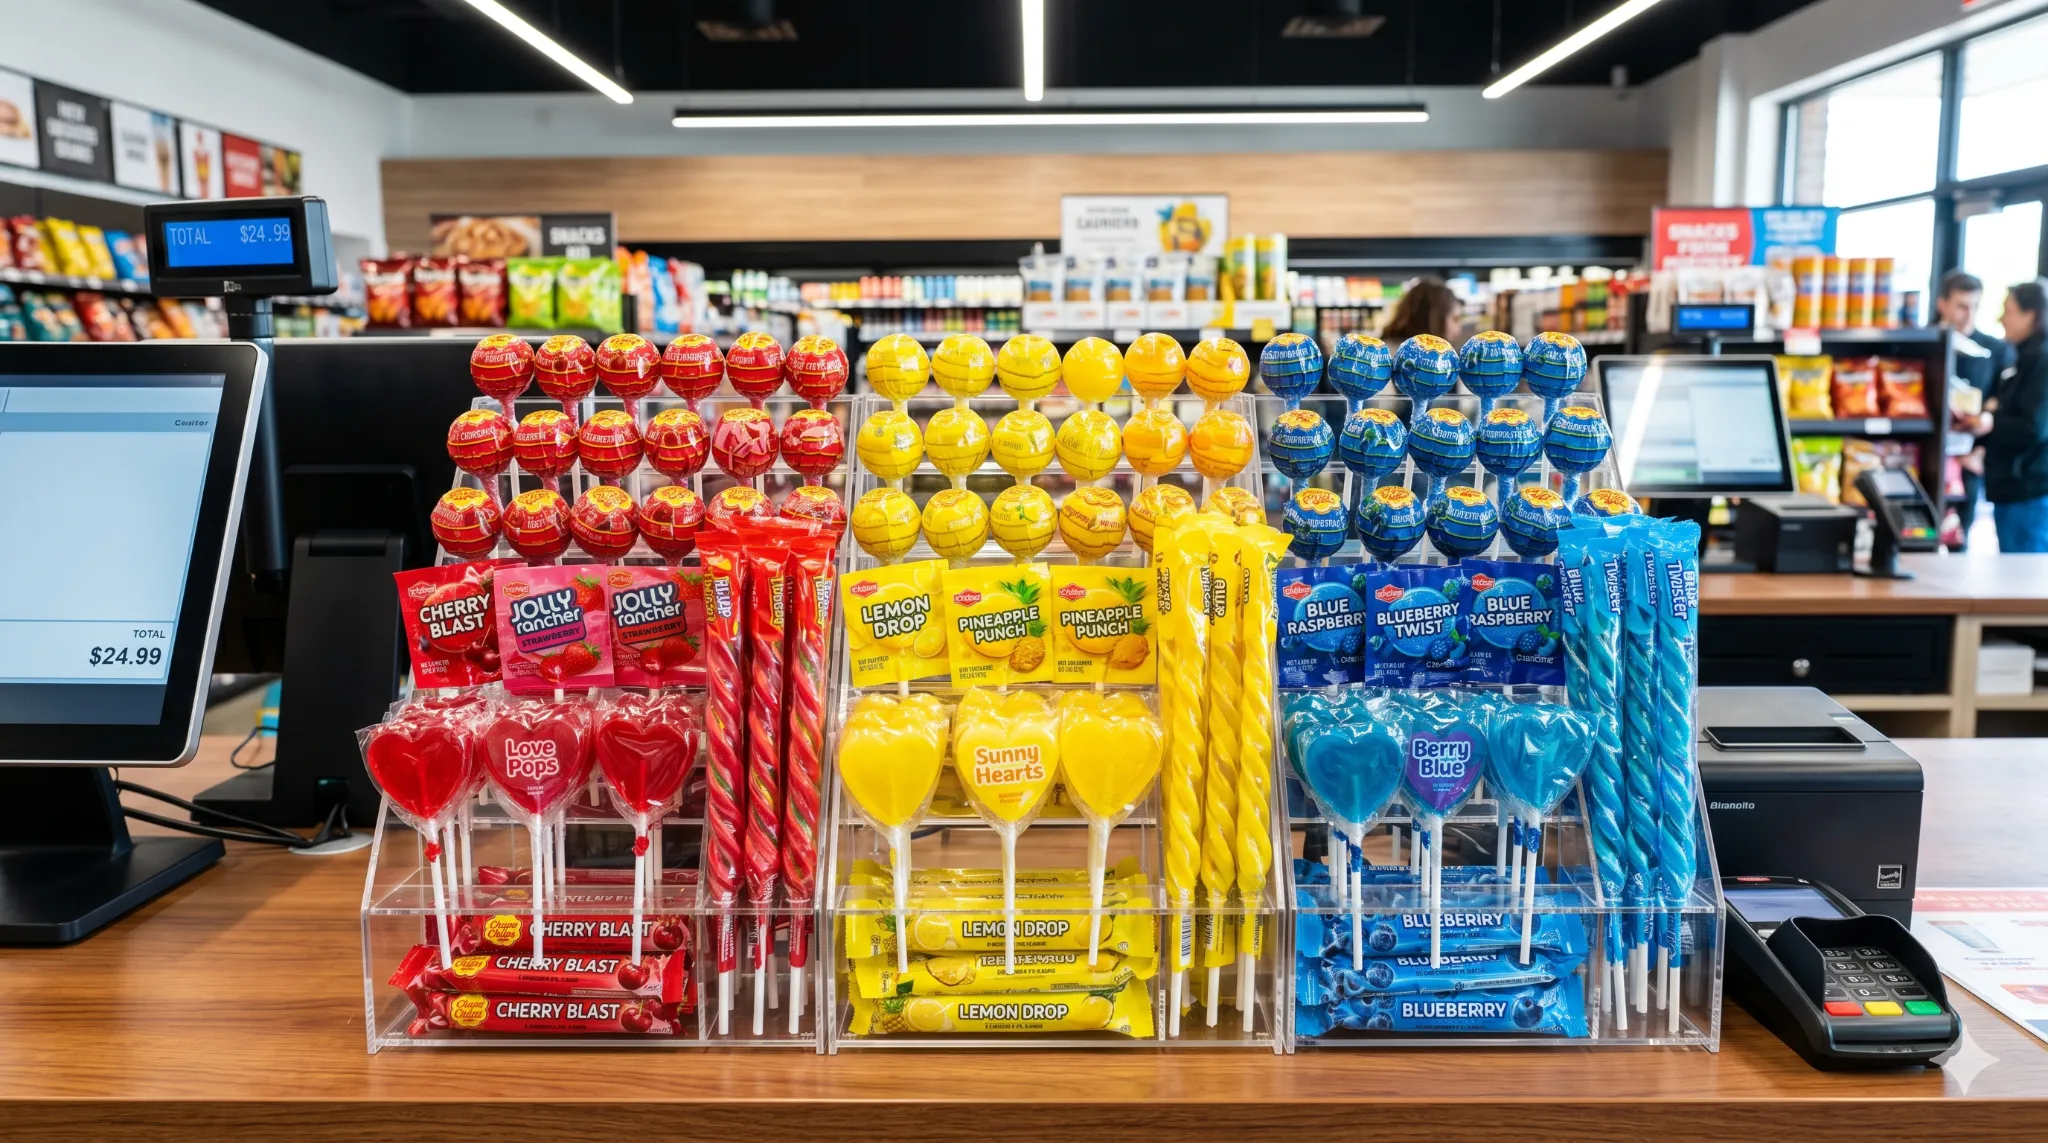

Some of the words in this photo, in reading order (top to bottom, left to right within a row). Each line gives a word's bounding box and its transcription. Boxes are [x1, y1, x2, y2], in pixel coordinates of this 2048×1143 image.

[169, 227, 212, 245] TOTAL
[240, 223, 290, 244] $24.99
[420, 593, 490, 623] CHERRY
[512, 590, 571, 623] JOLLY
[613, 584, 673, 615] JOLLY
[862, 595, 929, 623] LEMON
[1307, 598, 1349, 618] BLUE
[1486, 595, 1531, 612] BLUE
[516, 608, 580, 635] rancher
[618, 603, 681, 627] rancher
[959, 606, 1039, 631] PINEAPPLE
[1061, 605, 1142, 625] PINEAPPLE
[1376, 602, 1460, 626] BLUEBERRY
[1470, 610, 1553, 626] RASPBERRY
[132, 629, 166, 639] TOTAL
[430, 613, 485, 638] BLAST
[622, 621, 681, 639] STRAWBERRY
[873, 613, 926, 638] DROP
[975, 623, 1026, 644] PUNCH
[1076, 621, 1128, 638] PUNCH
[1394, 619, 1443, 638] TWIST
[521, 627, 580, 647] STRAWBERRY
[89, 646, 162, 667] $24.99
[506, 739, 556, 759] Love
[976, 746, 1039, 765] Sunny
[1414, 740, 1469, 761] Berry
[507, 757, 559, 779] Pops
[975, 764, 1044, 785] Hearts
[1421, 759, 1464, 776] Blue
[599, 921, 652, 937] BLAT
[1023, 920, 1069, 937] DROP
[496, 956, 562, 971] CHERRY
[563, 958, 619, 974] BLAST
[496, 1002, 565, 1019] CHERRY
[566, 1003, 620, 1019] BLAST
[958, 1004, 1019, 1020] LEMON
[1022, 1004, 1069, 1020] DROP
